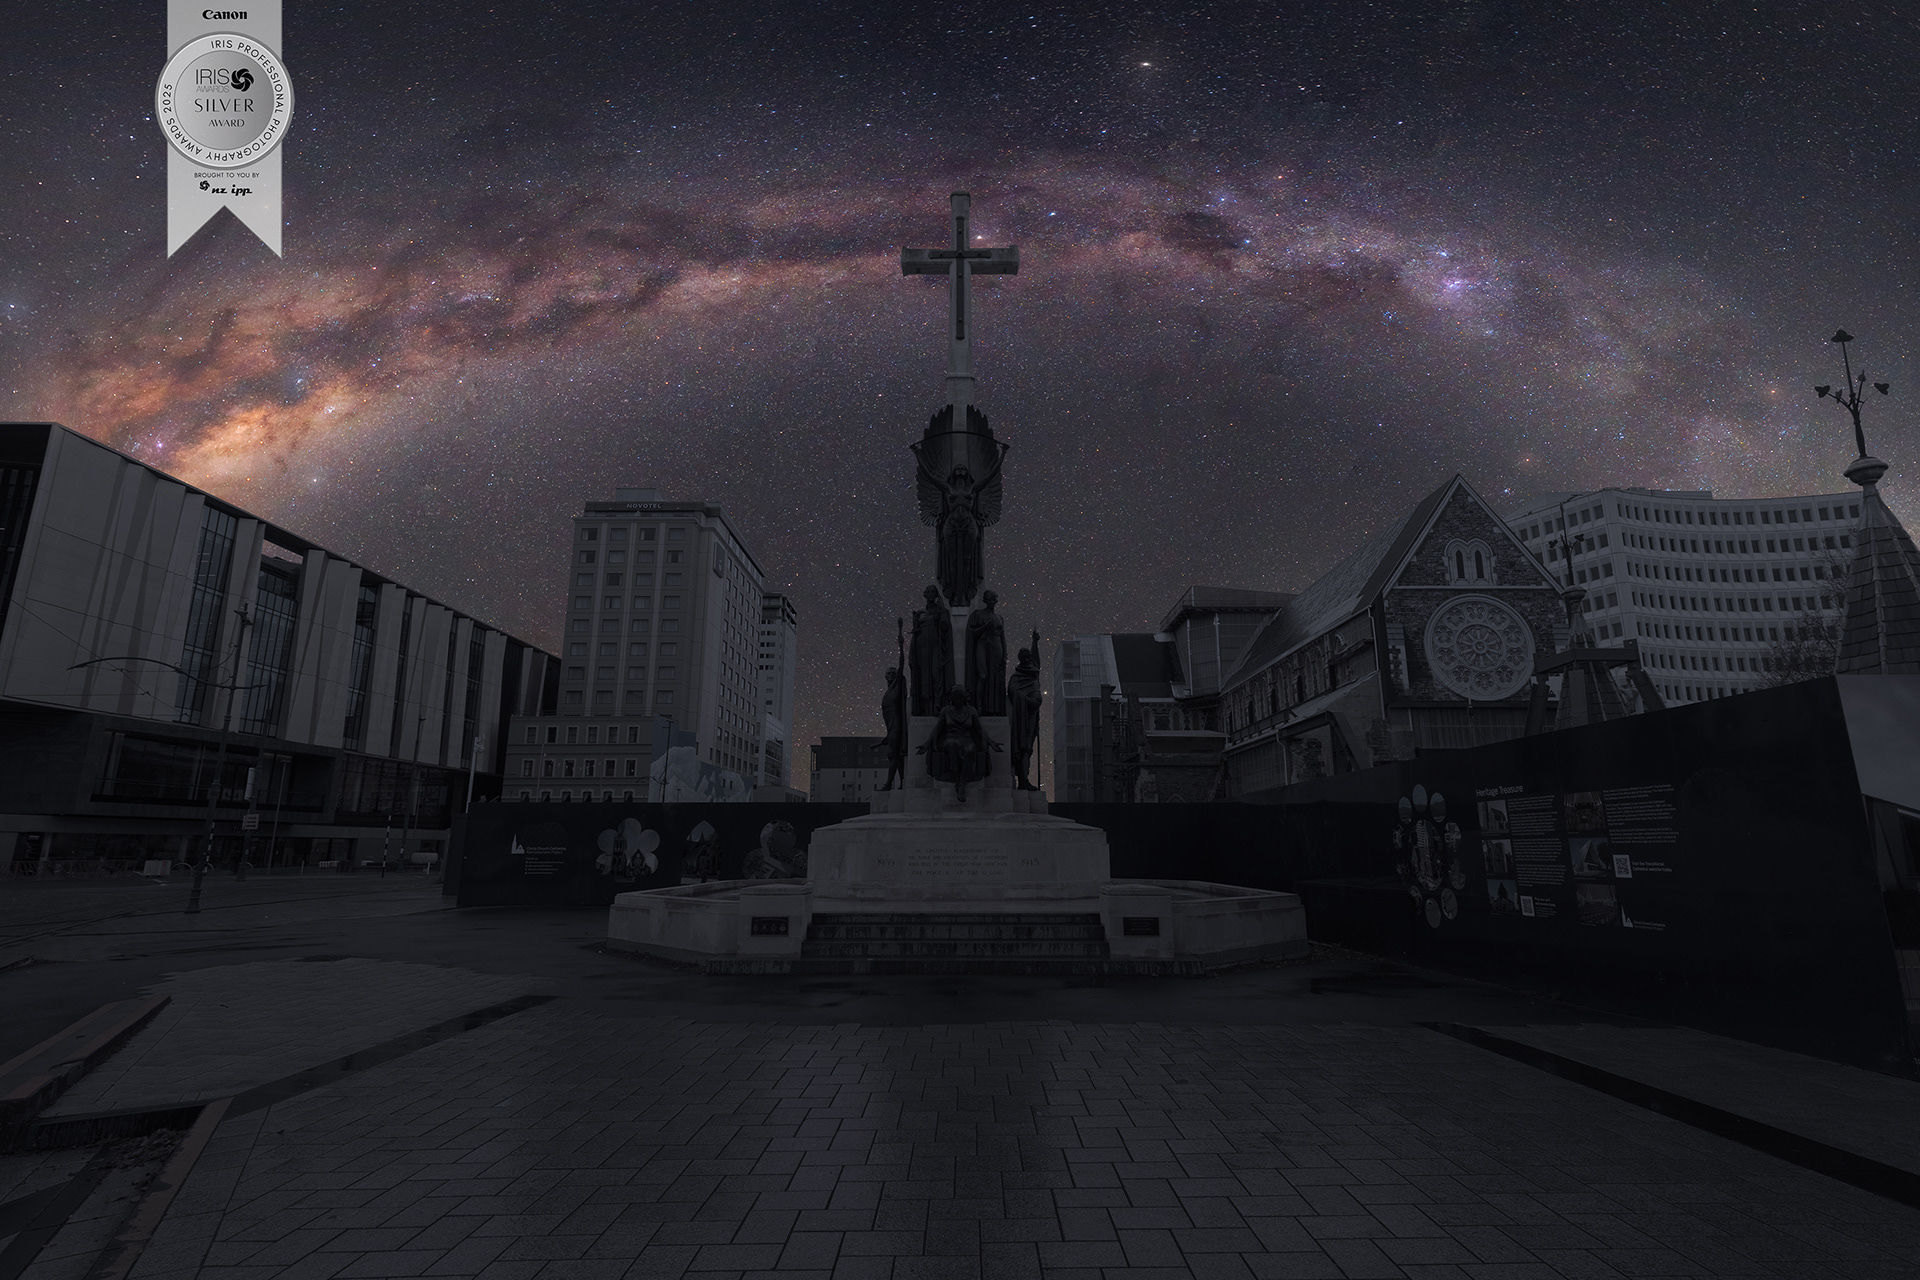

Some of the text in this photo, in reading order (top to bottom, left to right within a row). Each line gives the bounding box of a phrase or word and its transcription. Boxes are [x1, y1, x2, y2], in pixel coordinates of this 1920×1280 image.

[1475, 785, 1524, 797] Heritage Treasure
[877, 858, 895, 867] 1939
[1021, 858, 1040, 867] 1945
